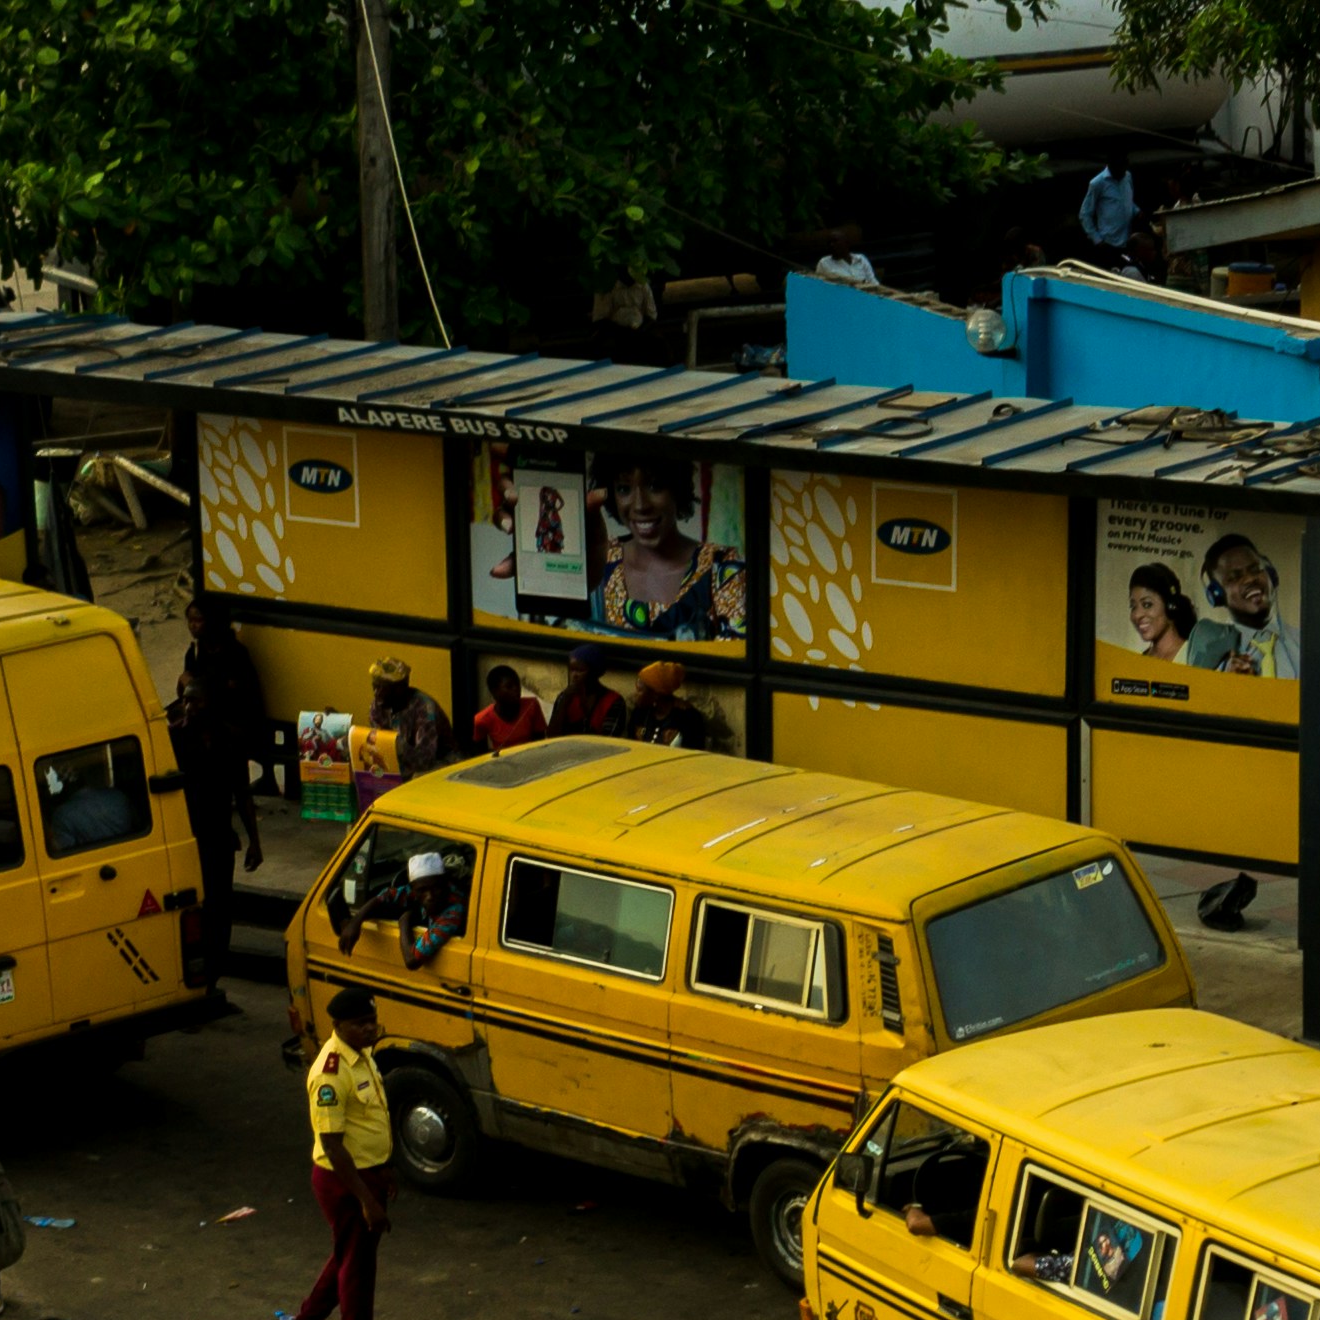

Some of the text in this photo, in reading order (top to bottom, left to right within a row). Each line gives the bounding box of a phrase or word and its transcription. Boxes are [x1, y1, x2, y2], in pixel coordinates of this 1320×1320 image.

[337, 406, 569, 445] ALAPERE BUS STOP
[300, 466, 342, 488] MTN
[1110, 499, 1230, 520] There's a tune for
[1108, 514, 1204, 534] every groove.
[890, 525, 939, 549] MTN
[1107, 530, 1182, 545] on MTN Music+
[1107, 542, 1195, 559] everywhere you go.
